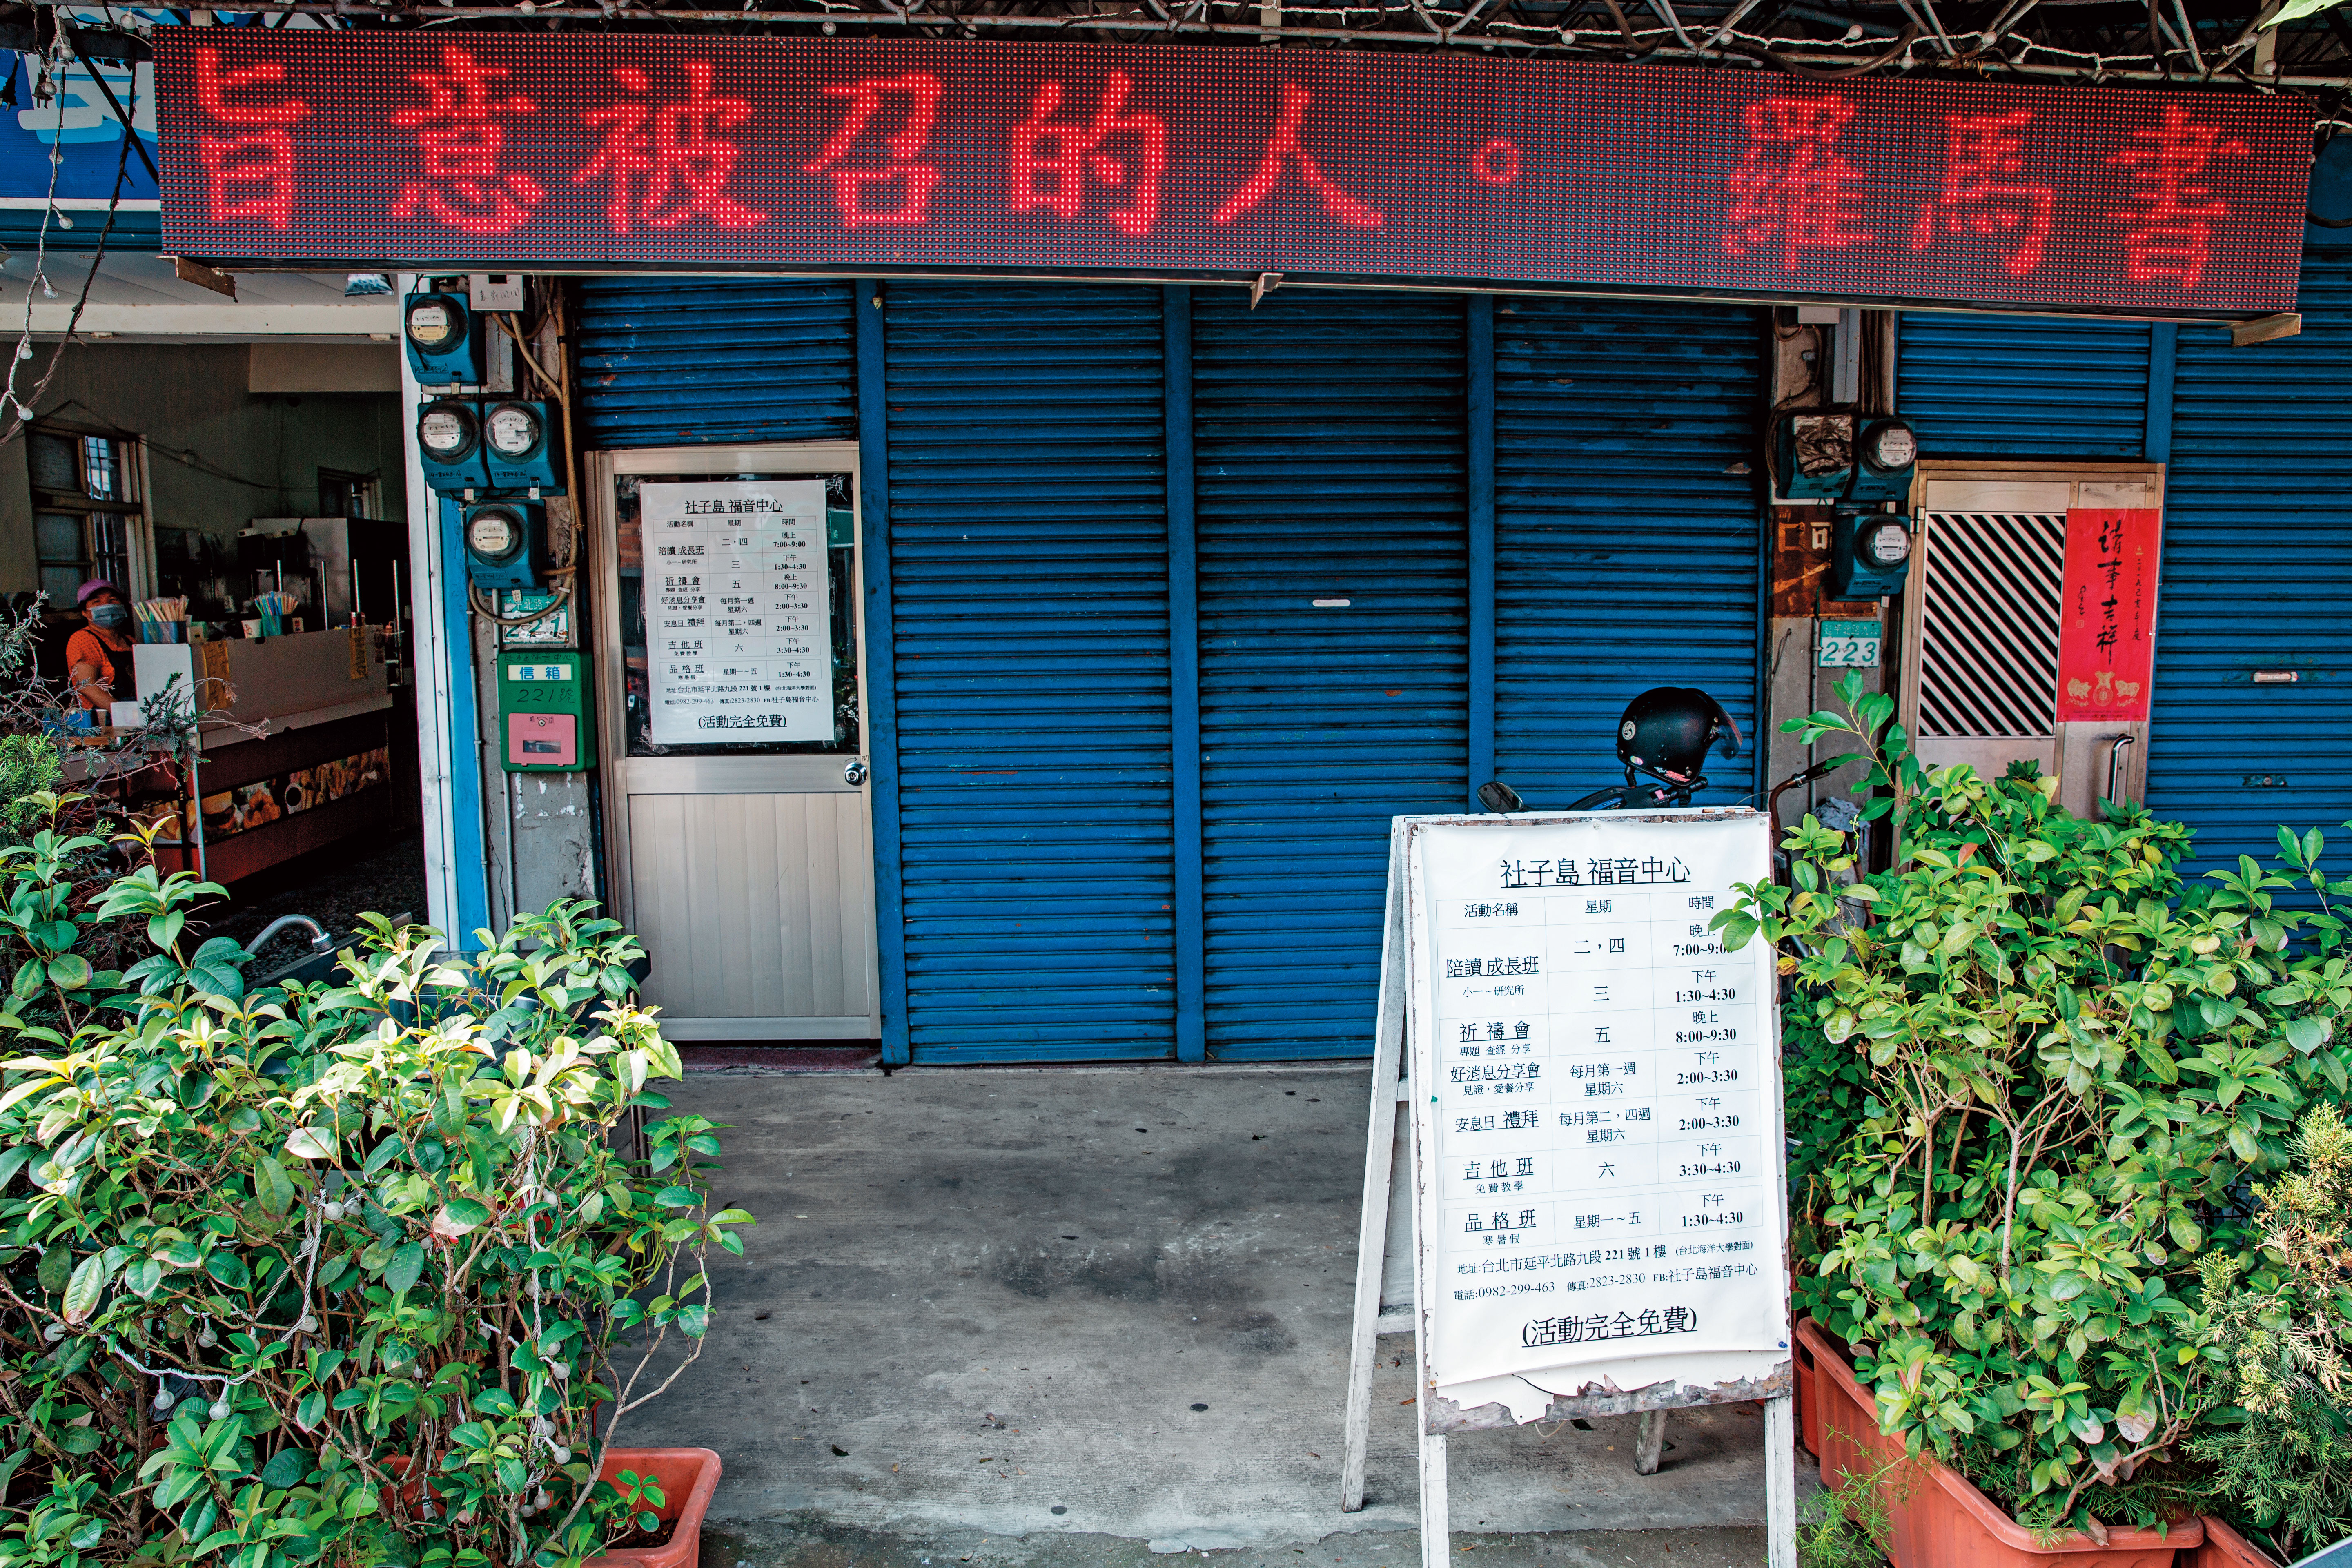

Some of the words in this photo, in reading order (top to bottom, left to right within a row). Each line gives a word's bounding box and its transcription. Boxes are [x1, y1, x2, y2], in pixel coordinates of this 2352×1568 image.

[195, 44, 1521, 236] 旨意被召的人。
[1720, 93, 2248, 291] 羅馬書
[685, 500, 726, 514] 社子島
[728, 499, 783, 513] 福音中心
[659, 546, 677, 555] 陪讀
[677, 546, 704, 555] 成長班
[2096, 519, 2123, 665] 諸事吉祥
[662, 596, 705, 604] 好消息分享會
[688, 618, 704, 627] 禮拜
[1823, 642, 1876, 662] 223
[519, 666, 560, 680] 信箱
[699, 714, 787, 728] (活動完全免費)
[1501, 858, 1581, 888] 社子島
[1585, 856, 1690, 885] 福音中心
[1585, 900, 1611, 913] 星期
[1689, 896, 1713, 909] 時間
[1465, 903, 1518, 917] 活動名稱
[1688, 922, 1717, 938] 晚上
[1574, 938, 1624, 953] 二，四
[1673, 943, 1733, 956] 7:00~9:0
[1446, 958, 1484, 978] 陪讀
[1484, 956, 1539, 976] 成長班
[1692, 970, 1716, 983] 下午
[1594, 986, 1609, 1001] 三
[1676, 988, 1735, 1002] 1:30~4:30
[1693, 1010, 1718, 1024] 晚上
[1594, 1027, 1610, 1042] 五
[1676, 1029, 1736, 1042] 8:00~9:30
[1460, 1046, 1479, 1056] 專題
[1486, 1045, 1505, 1055] 查經
[1512, 1044, 1530, 1054] 分享
[1694, 1051, 1719, 1065] 下午
[1451, 1062, 1540, 1084] 好消息分享會
[1570, 1062, 1635, 1078] 每月第一週
[1678, 1069, 1737, 1084] 2:00~3:30
[1585, 1082, 1623, 1096] 星期六
[1696, 1097, 1720, 1111] 下午
[1456, 1116, 1497, 1132] 安息日
[1501, 1110, 1539, 1129] 禮拜
[1559, 1107, 1650, 1126] 每月第二，四週
[1680, 1115, 1739, 1130] 2:00~3:30
[1586, 1129, 1625, 1143] 星期六
[1697, 1143, 1722, 1156] 下午
[1599, 1162, 1614, 1178] 六
[1680, 1161, 1740, 1176] 3:30~4:30
[1699, 1194, 1724, 1207] 下午
[1683, 1212, 1742, 1226] 1:30~4:30
[1459, 1250, 1601, 1274] 地址:台北市延平北路九段
[1606, 1250, 1623, 1260] 221
[1628, 1247, 1640, 1260] 號
[1645, 1247, 1650, 1258] 1
[1654, 1245, 1666, 1258] 樓
[1676, 1241, 1753, 1255] (台北海洋大學對面)
[1454, 1282, 1554, 1300] 電話:0982-299-463
[1568, 1274, 1645, 1291] 傳真:2823-2830
[1654, 1263, 1757, 1282] FB:社子島福音中心
[1522, 1306, 1697, 1347] (活動完全免費)
